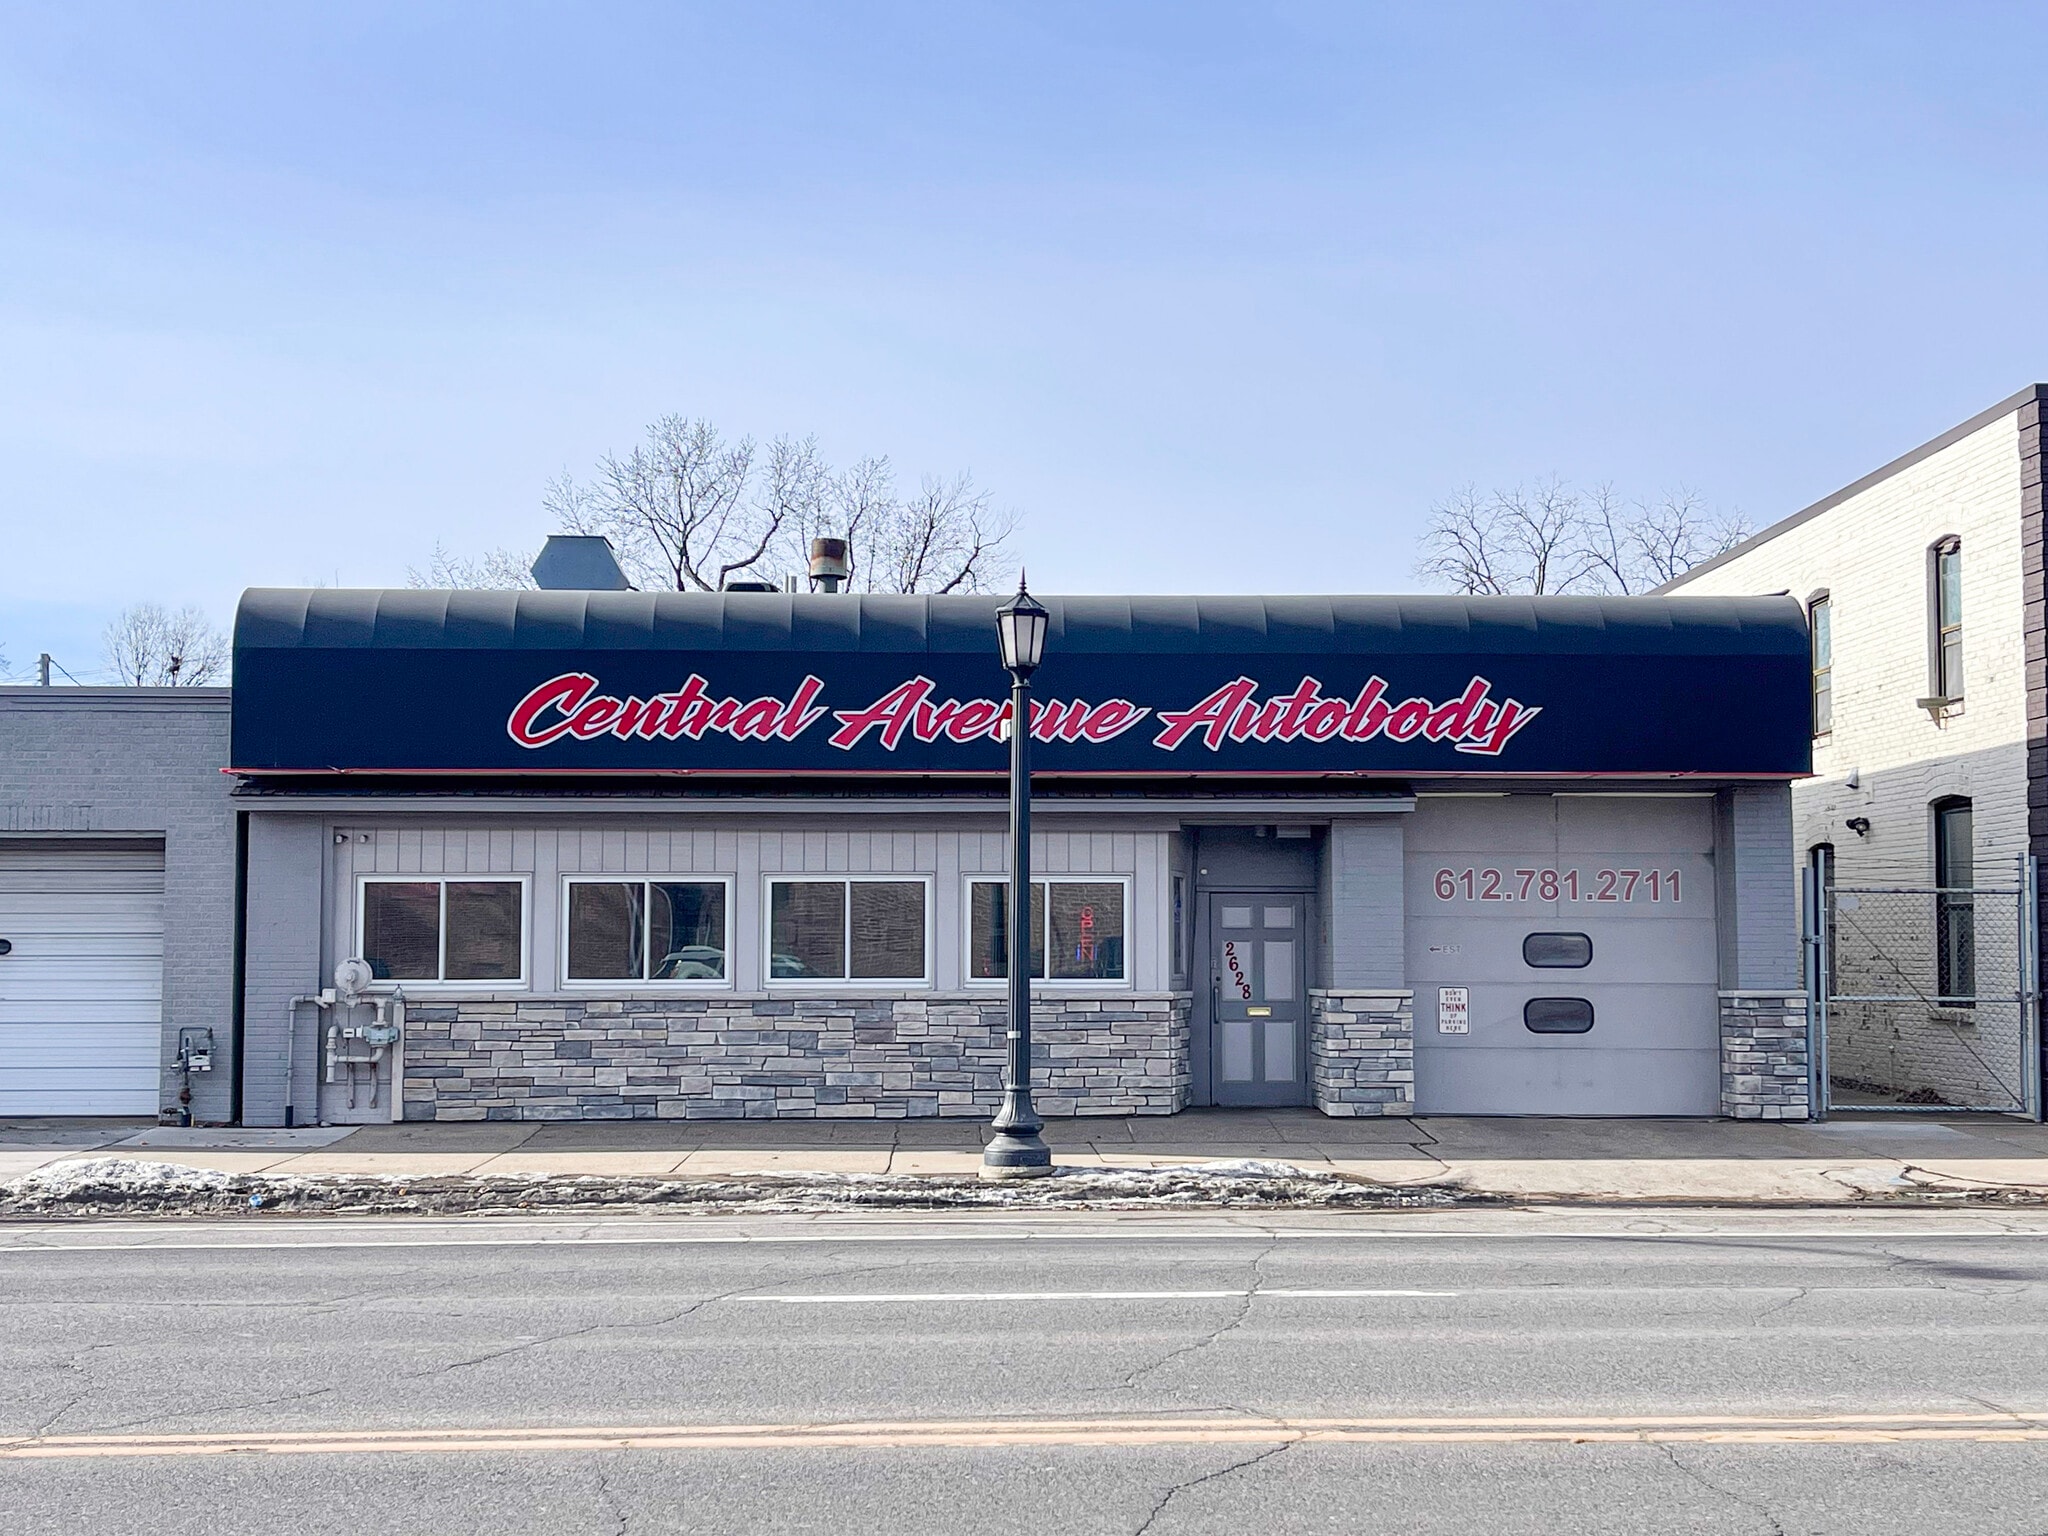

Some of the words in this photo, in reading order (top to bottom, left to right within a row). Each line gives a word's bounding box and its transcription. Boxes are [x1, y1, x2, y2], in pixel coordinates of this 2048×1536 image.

[507, 673, 830, 749] Central
[1153, 675, 1543, 756] Autobody
[1434, 867, 1682, 903] 612.781.2711
[1081, 906, 1094, 964] OPEN
[1225, 941, 1251, 1000] 2628
[1441, 1003, 1466, 1012] THINK
